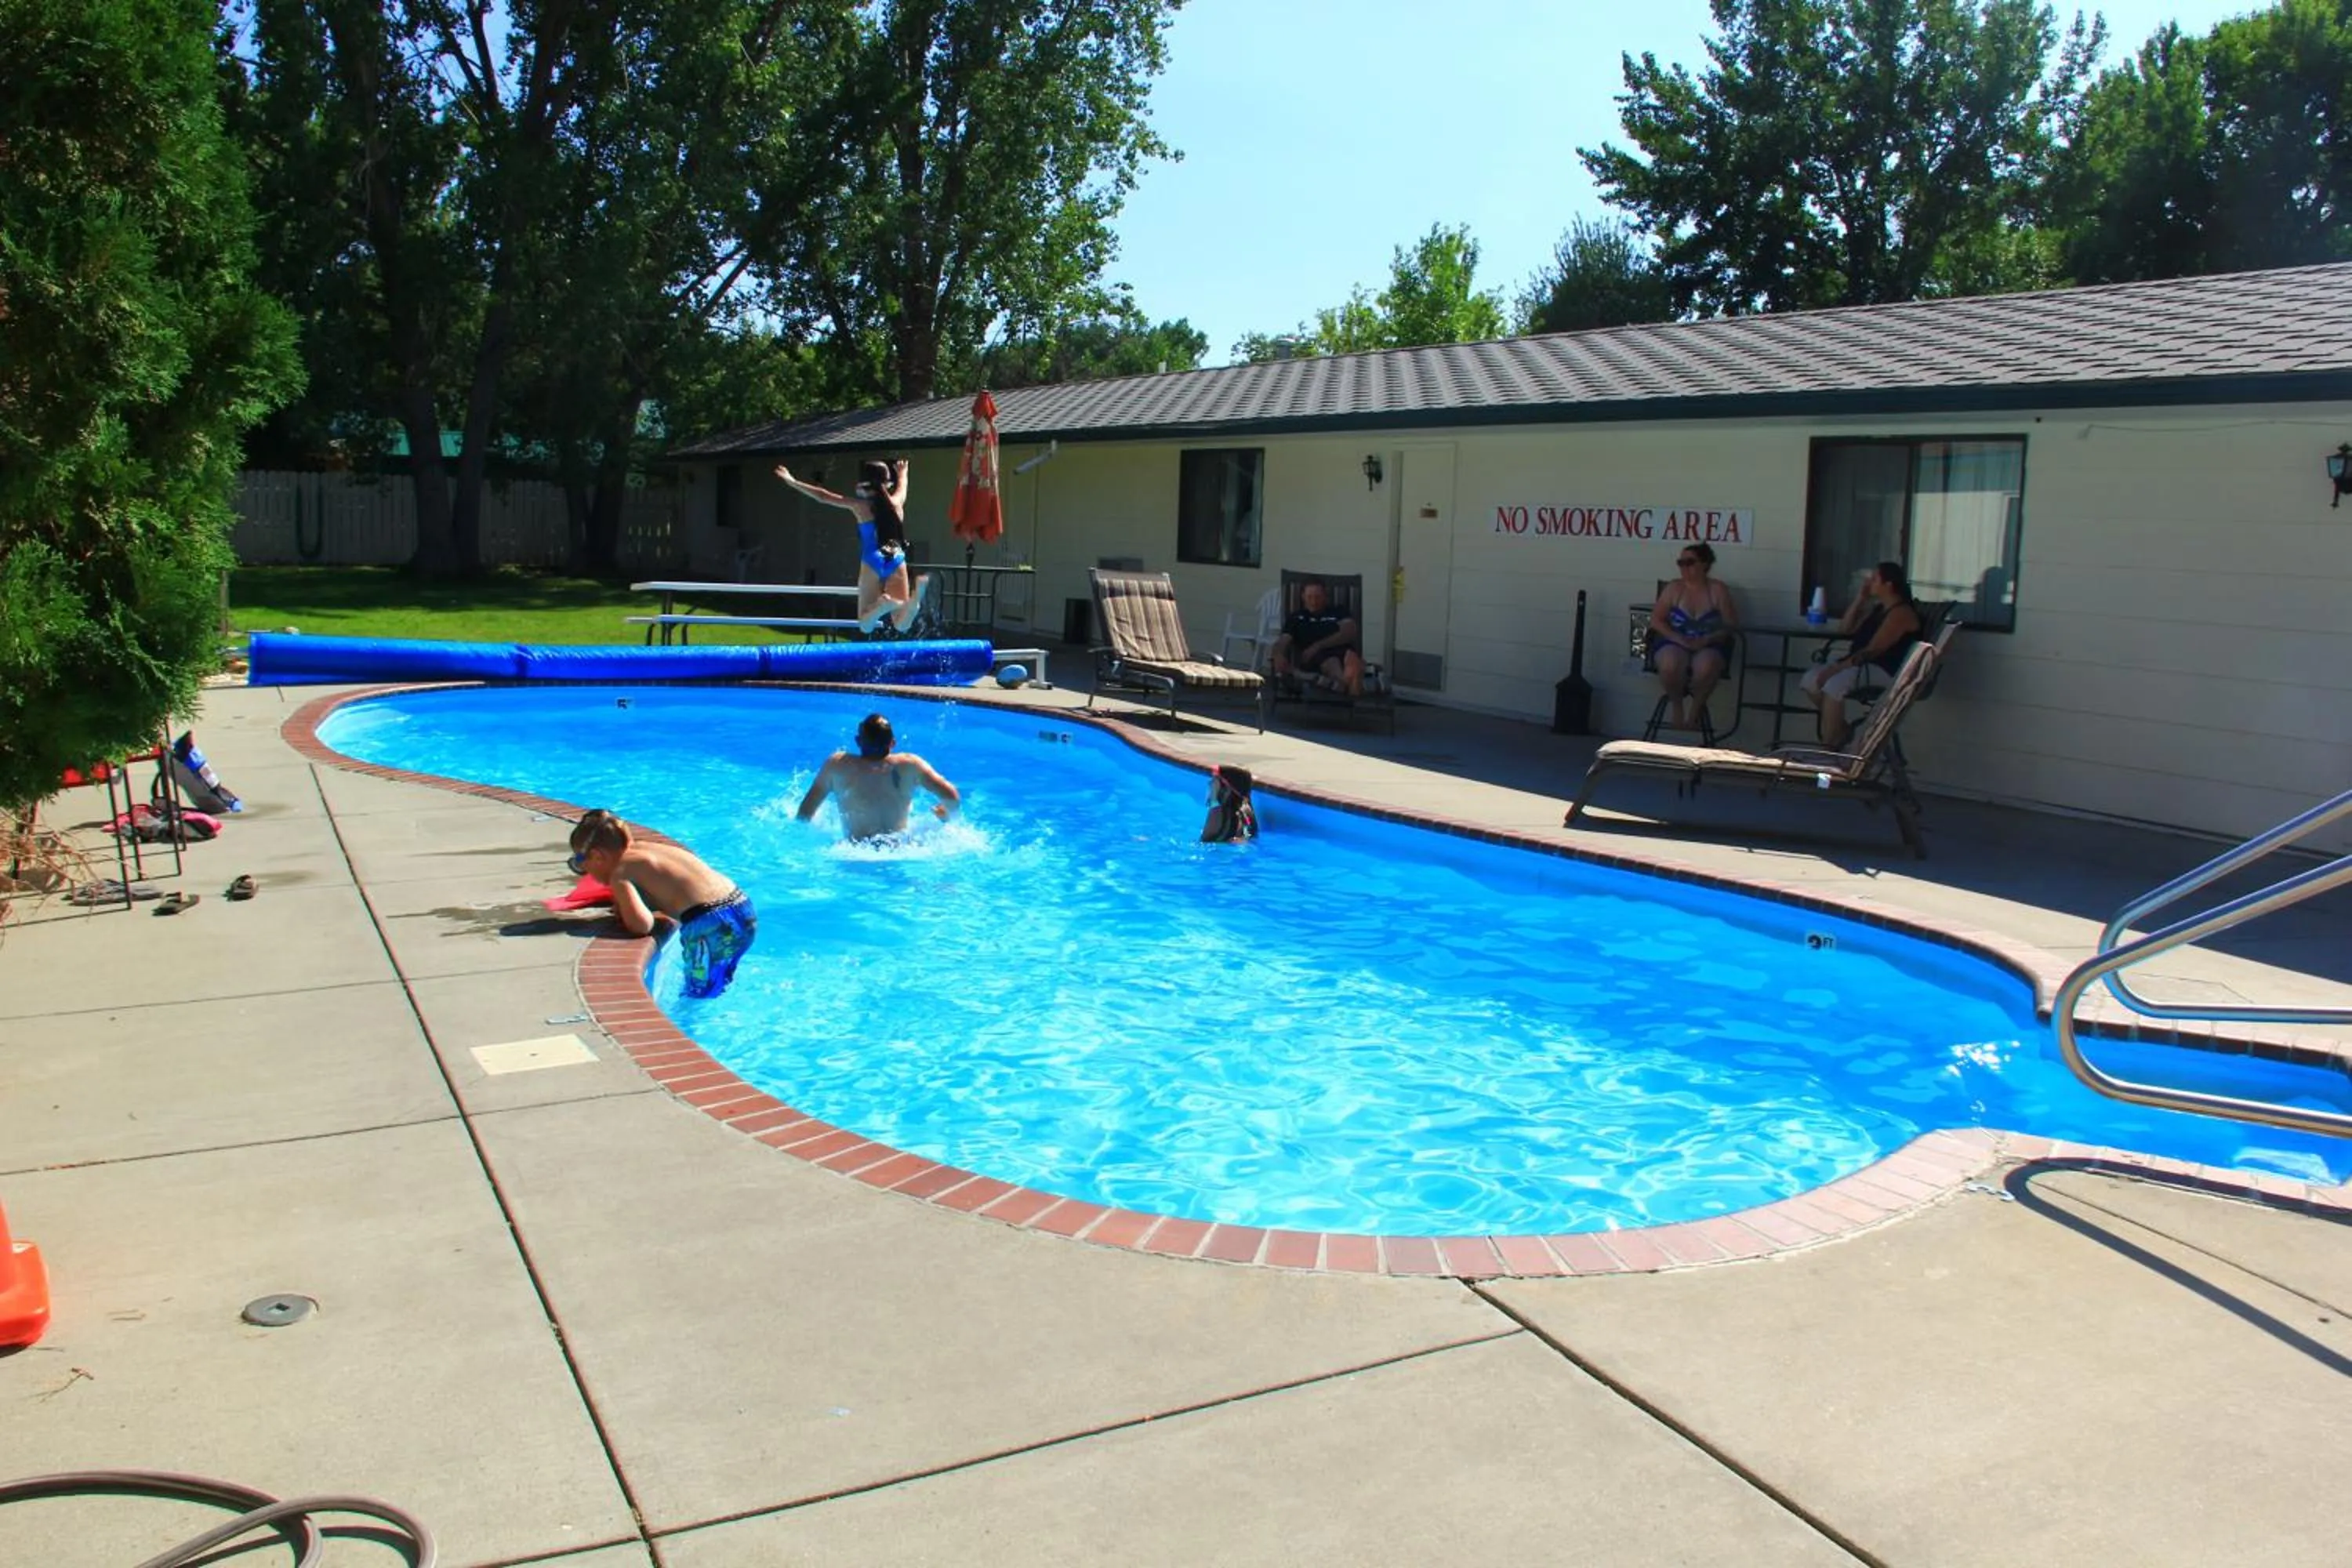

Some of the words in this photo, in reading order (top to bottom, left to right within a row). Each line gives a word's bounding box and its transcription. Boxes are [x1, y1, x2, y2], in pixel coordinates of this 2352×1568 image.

[1495, 506, 1529, 534] NO
[1535, 506, 1653, 539] SMOKING
[1661, 510, 1742, 543] AREA
